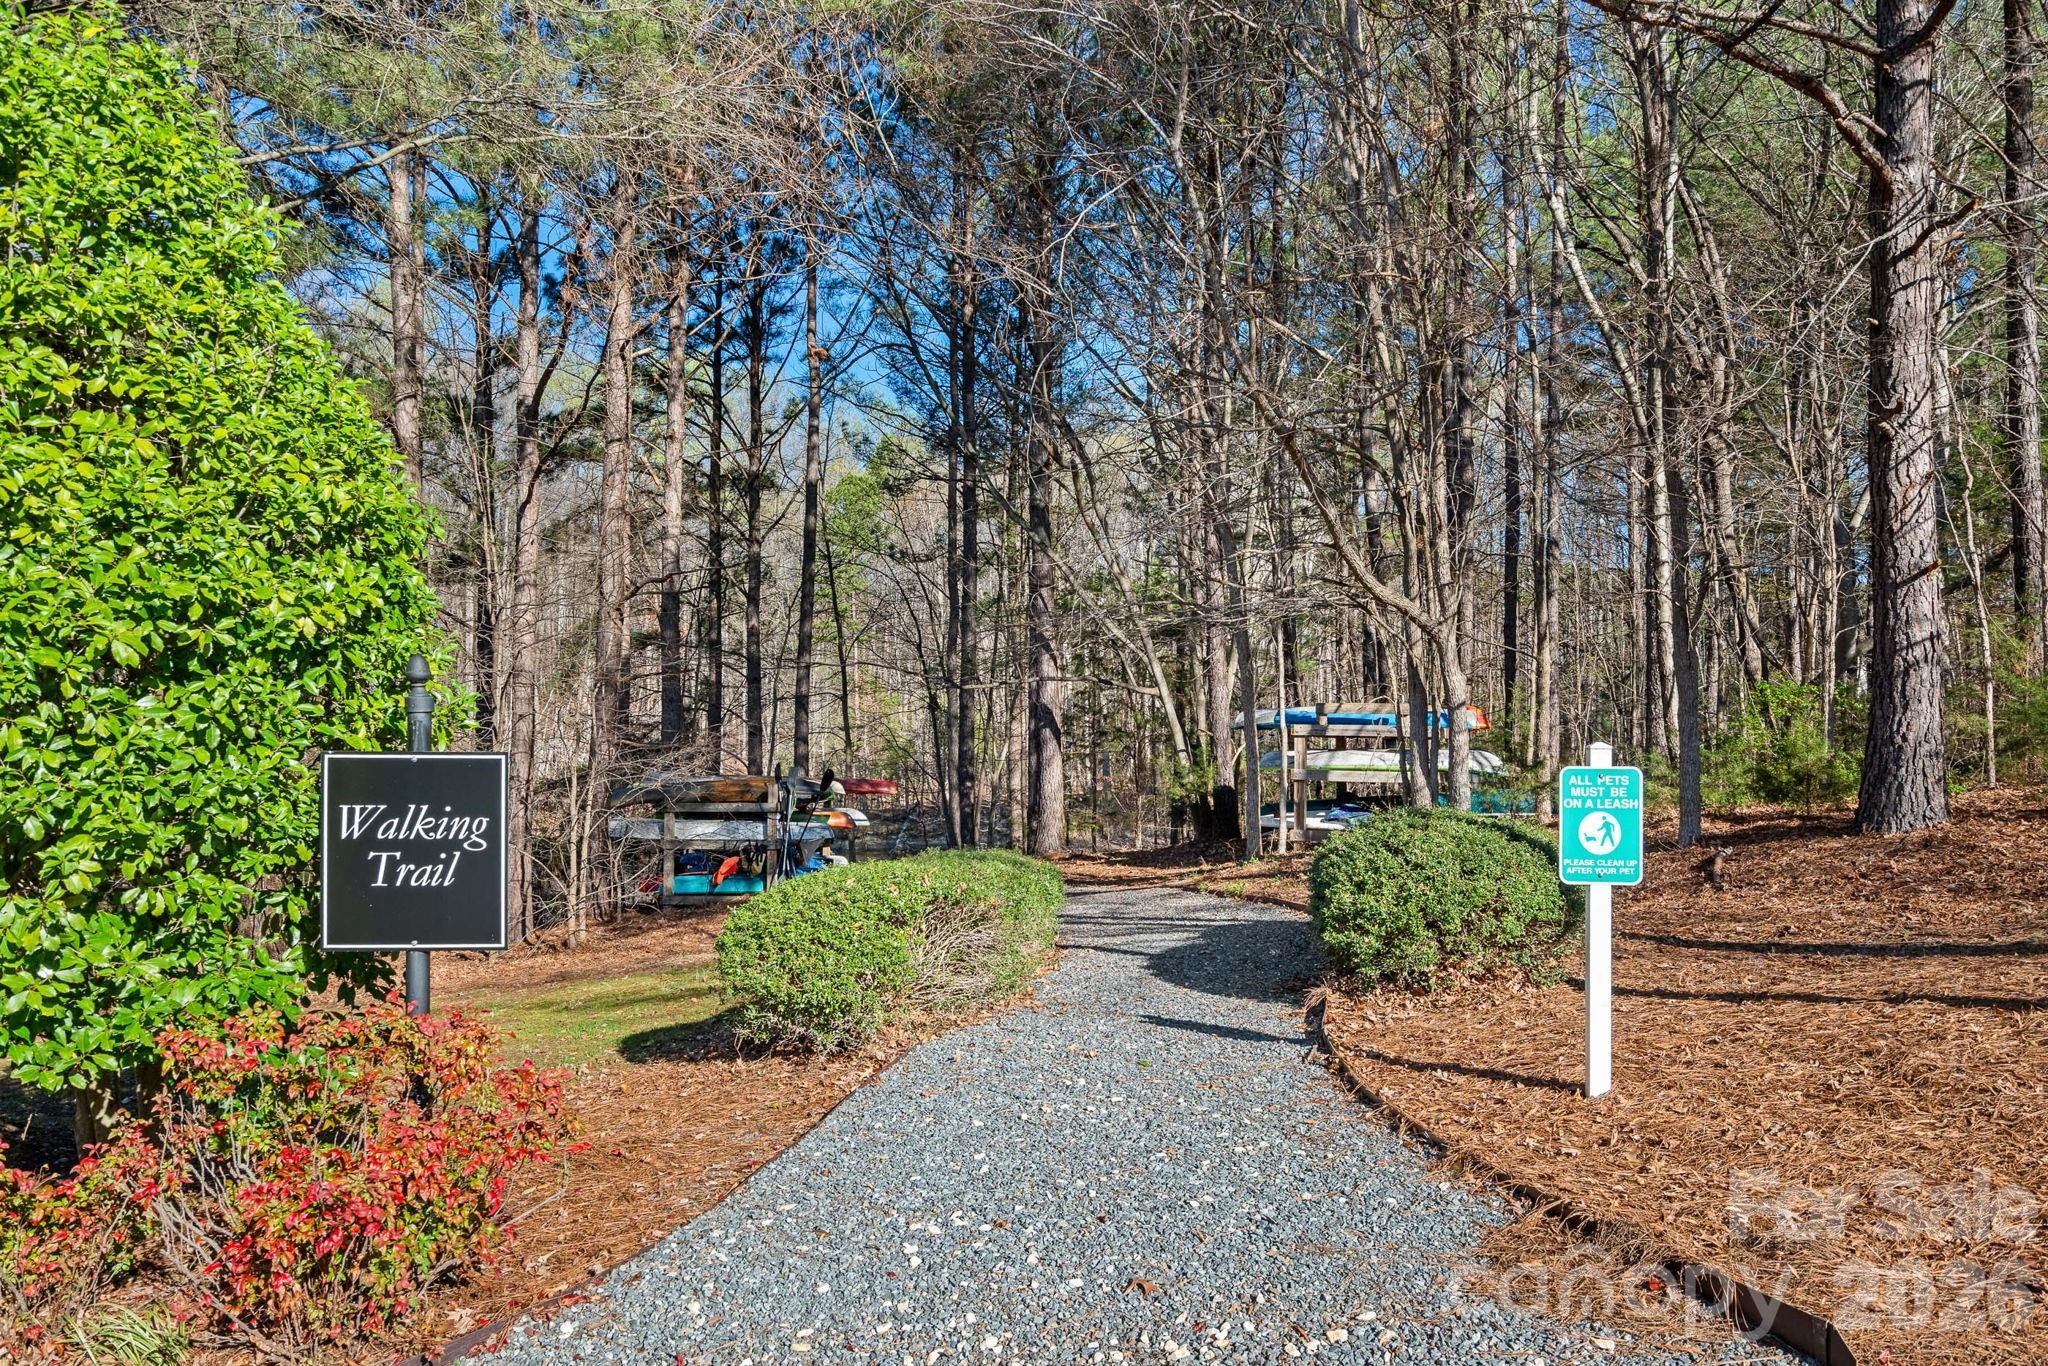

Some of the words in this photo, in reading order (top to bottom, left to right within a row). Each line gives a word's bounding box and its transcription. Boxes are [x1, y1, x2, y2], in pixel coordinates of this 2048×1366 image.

[1568, 775, 1592, 785] ALL
[1597, 775, 1630, 785] PETS
[1570, 787, 1605, 797] MUST
[1610, 787, 1628, 797] BE
[1563, 799, 1582, 808] ON
[1584, 799, 1595, 808] A
[1596, 799, 1639, 809] LEASH
[338, 804, 490, 851] Walking
[1597, 859, 1625, 867] CLEAN
[1626, 859, 1638, 867] UP
[367, 851, 461, 887] Trail
[1595, 867, 1617, 875] YOUR
[1619, 867, 1635, 875] PET
